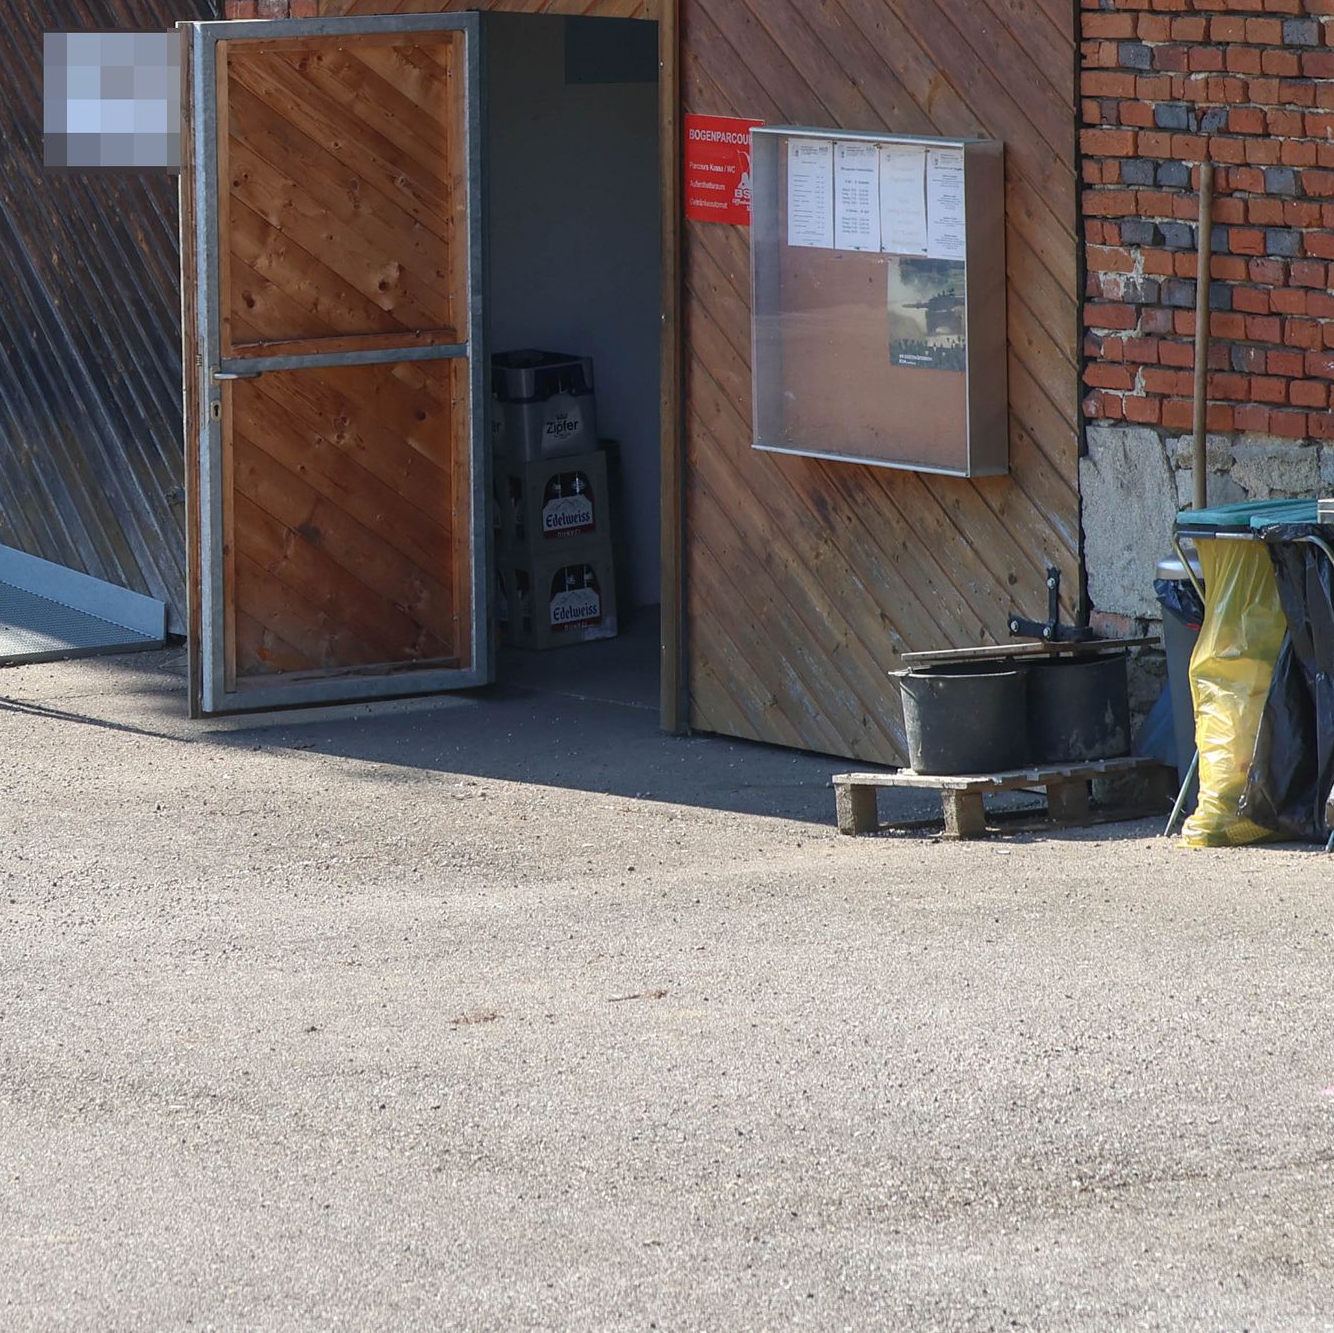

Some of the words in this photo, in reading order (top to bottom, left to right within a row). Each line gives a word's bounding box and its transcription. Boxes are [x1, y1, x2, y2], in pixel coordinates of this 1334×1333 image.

[547, 420, 579, 434] Zipfer
[546, 509, 591, 527] Edelweiss
[553, 602, 597, 621] Edelweiss
